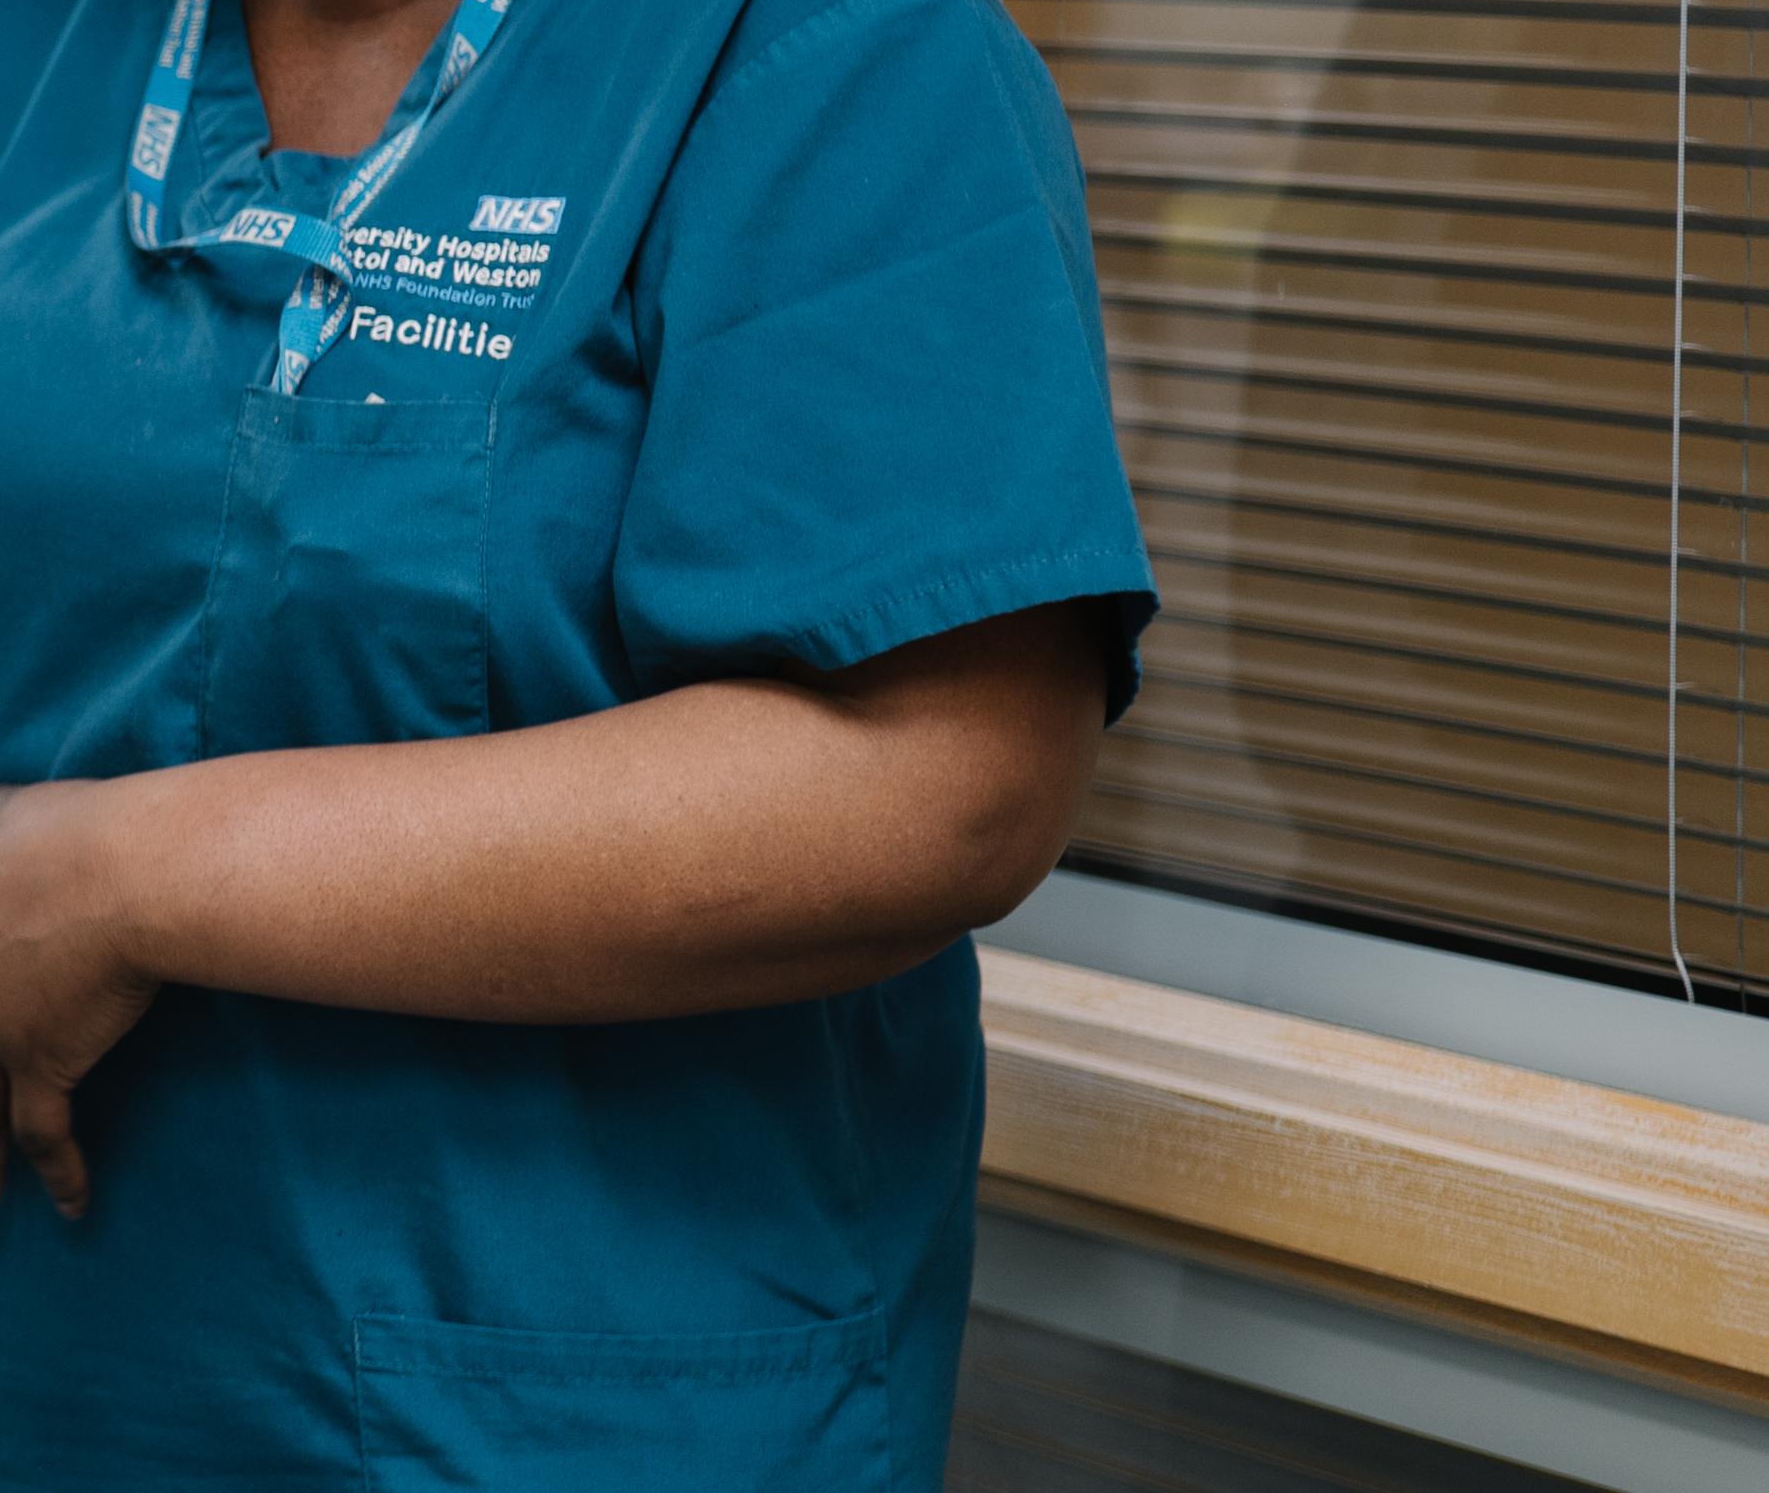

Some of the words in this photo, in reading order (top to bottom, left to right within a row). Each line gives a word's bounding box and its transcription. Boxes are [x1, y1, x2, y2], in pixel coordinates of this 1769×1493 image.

[134, 106, 179, 178] NHS
[225, 209, 293, 246] NHS
[471, 196, 564, 233] NHS
[345, 226, 431, 256] versity
[437, 234, 551, 265] Hospitals
[395, 253, 445, 280] and
[453, 260, 541, 289] Weston
[354, 272, 391, 291] NHS
[396, 275, 496, 309] Foundation
[350, 305, 514, 360] Facilitie
